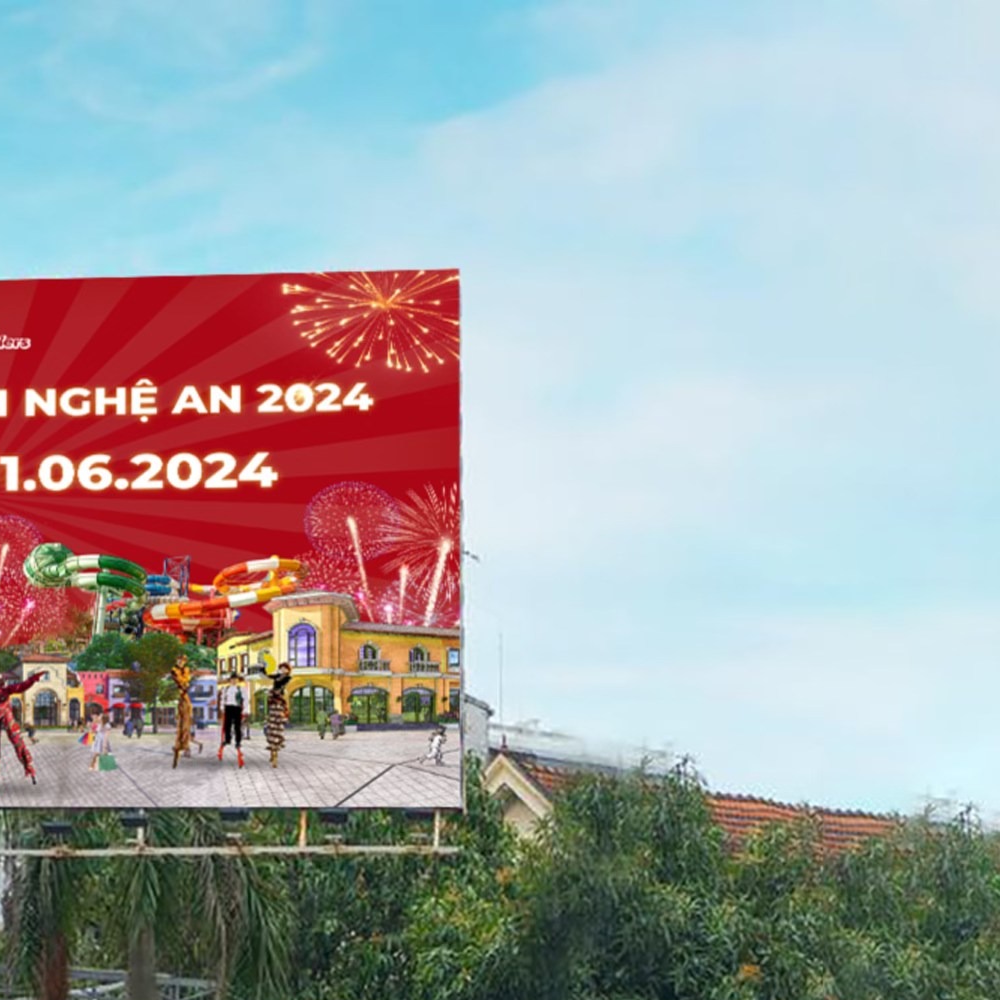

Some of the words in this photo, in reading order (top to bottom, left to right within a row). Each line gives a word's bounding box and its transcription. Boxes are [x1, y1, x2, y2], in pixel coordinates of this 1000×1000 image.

[24, 378, 158, 423] NGHỆ
[171, 384, 242, 414] AN
[256, 381, 375, 414] 2024
